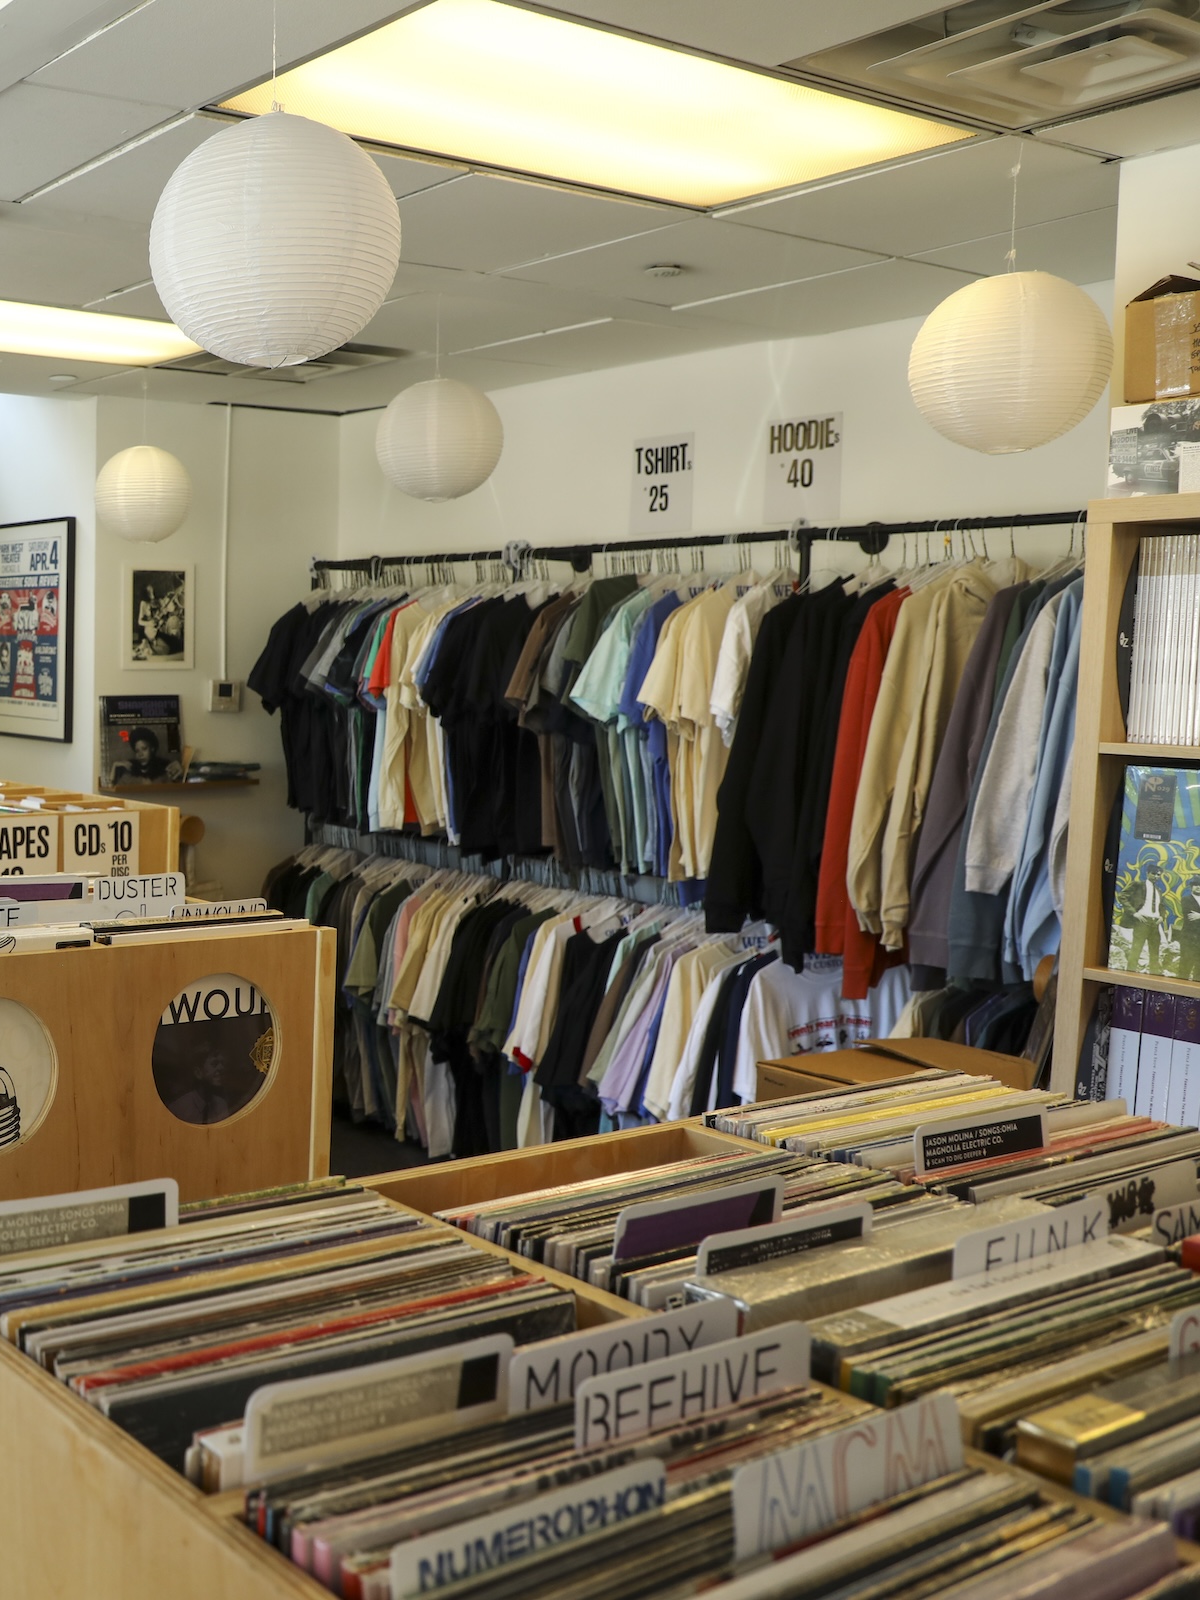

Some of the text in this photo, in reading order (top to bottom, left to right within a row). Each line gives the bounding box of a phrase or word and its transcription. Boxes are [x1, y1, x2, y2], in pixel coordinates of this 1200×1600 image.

[30, 540, 59, 571] APR. 4
[111, 866, 130, 877] DISC
[112, 855, 128, 866] PER
[98, 876, 178, 900] DUSTER
[925, 1136, 947, 1148] JASON
[948, 1131, 974, 1144] MOLINA
[925, 1135, 1004, 1157] MAGNOLIA ELECTRIC CO.
[6, 1209, 49, 1230] MOLINA
[29, 1220, 78, 1238] ELECTRIC
[583, 1342, 781, 1448] BEEHIVE
[757, 1398, 949, 1552] MCM
[418, 1477, 667, 1592] NUMEROPHON
